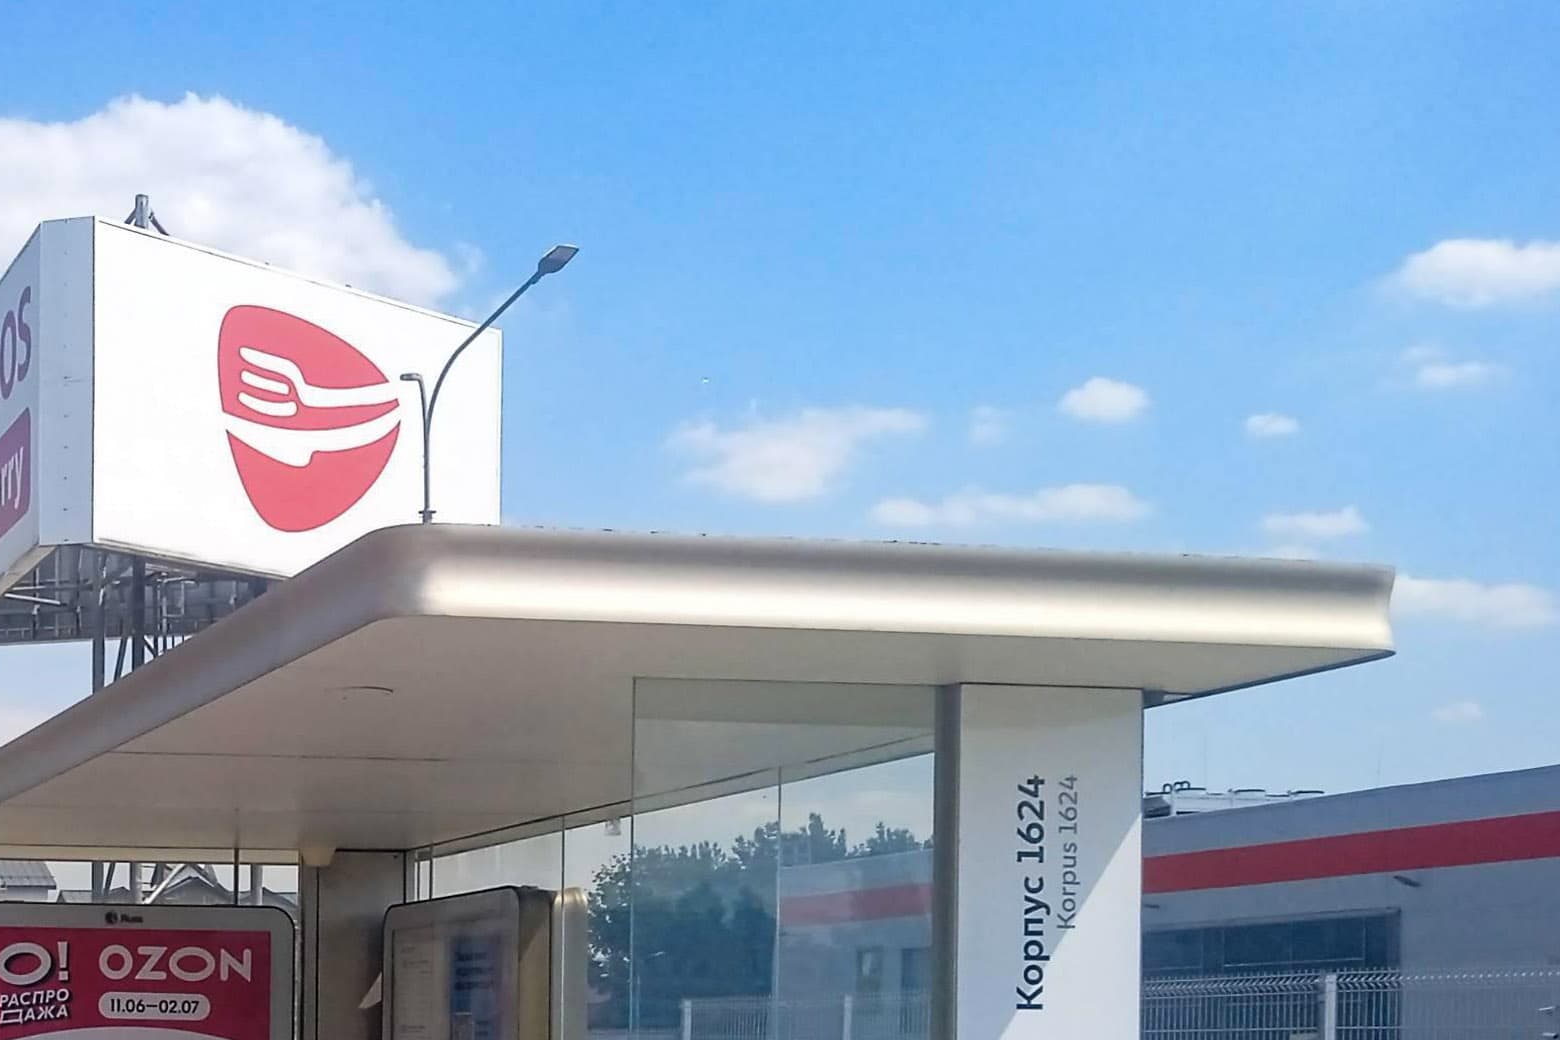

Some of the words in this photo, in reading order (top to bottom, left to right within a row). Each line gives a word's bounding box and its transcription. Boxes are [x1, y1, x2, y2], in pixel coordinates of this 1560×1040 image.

[1015, 773, 1046, 864] 1624
[1057, 774, 1079, 836] 1624
[1056, 841, 1081, 930] Korpus
[98, 943, 253, 983] OZON
[1015, 875, 1052, 1011] Корпус
